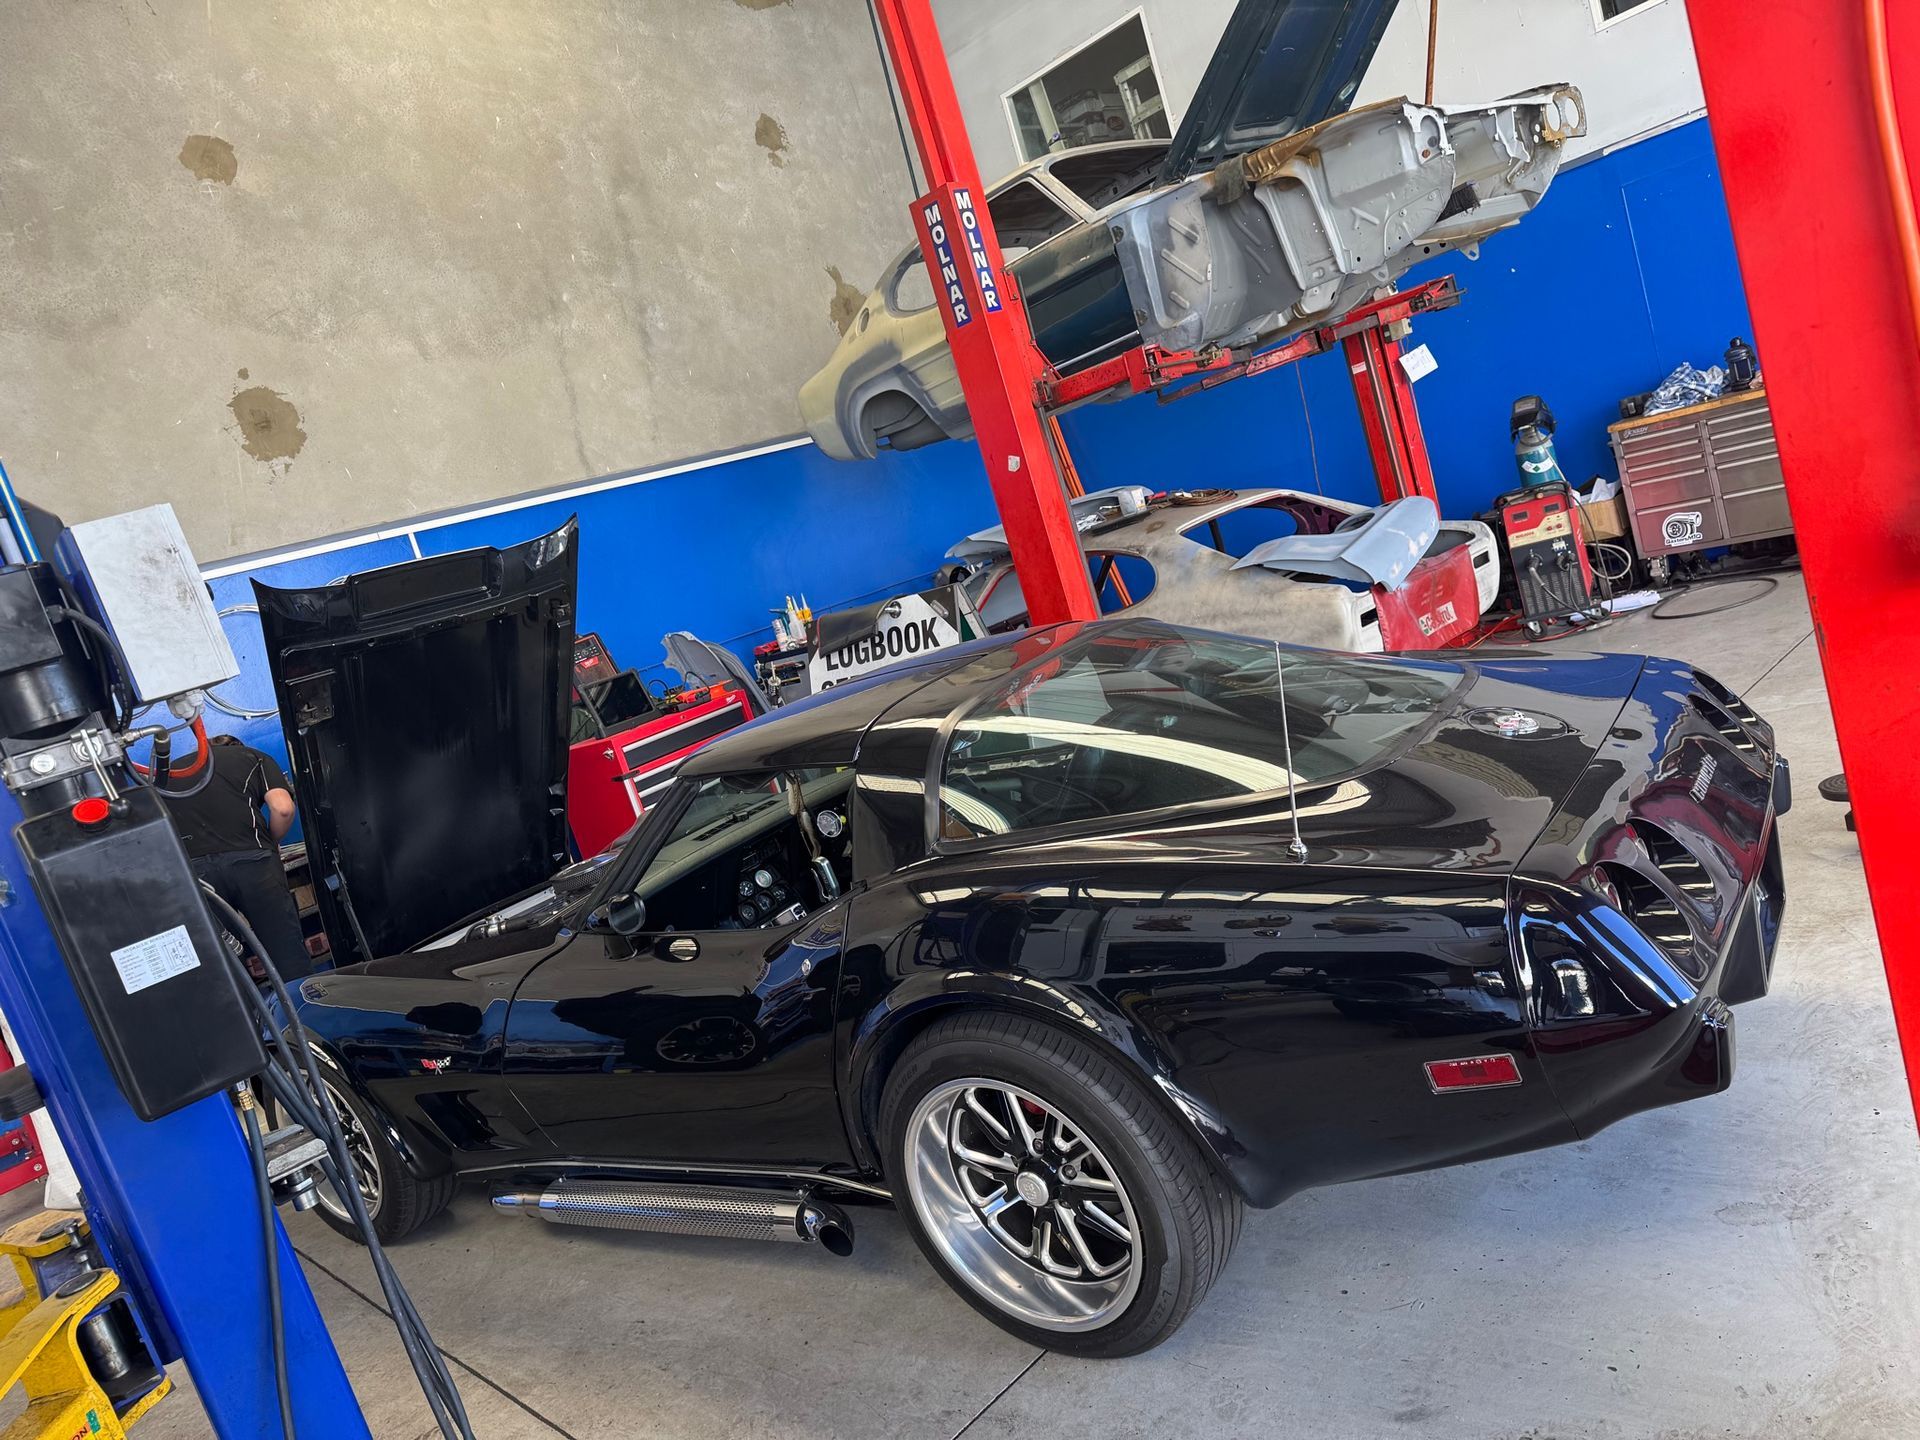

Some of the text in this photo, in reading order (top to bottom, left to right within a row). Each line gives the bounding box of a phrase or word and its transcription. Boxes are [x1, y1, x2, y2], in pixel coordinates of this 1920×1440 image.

[924, 204, 969, 322] MOLNAR
[954, 191, 999, 308] MOLNAR
[826, 617, 940, 671] LOGBOOK
